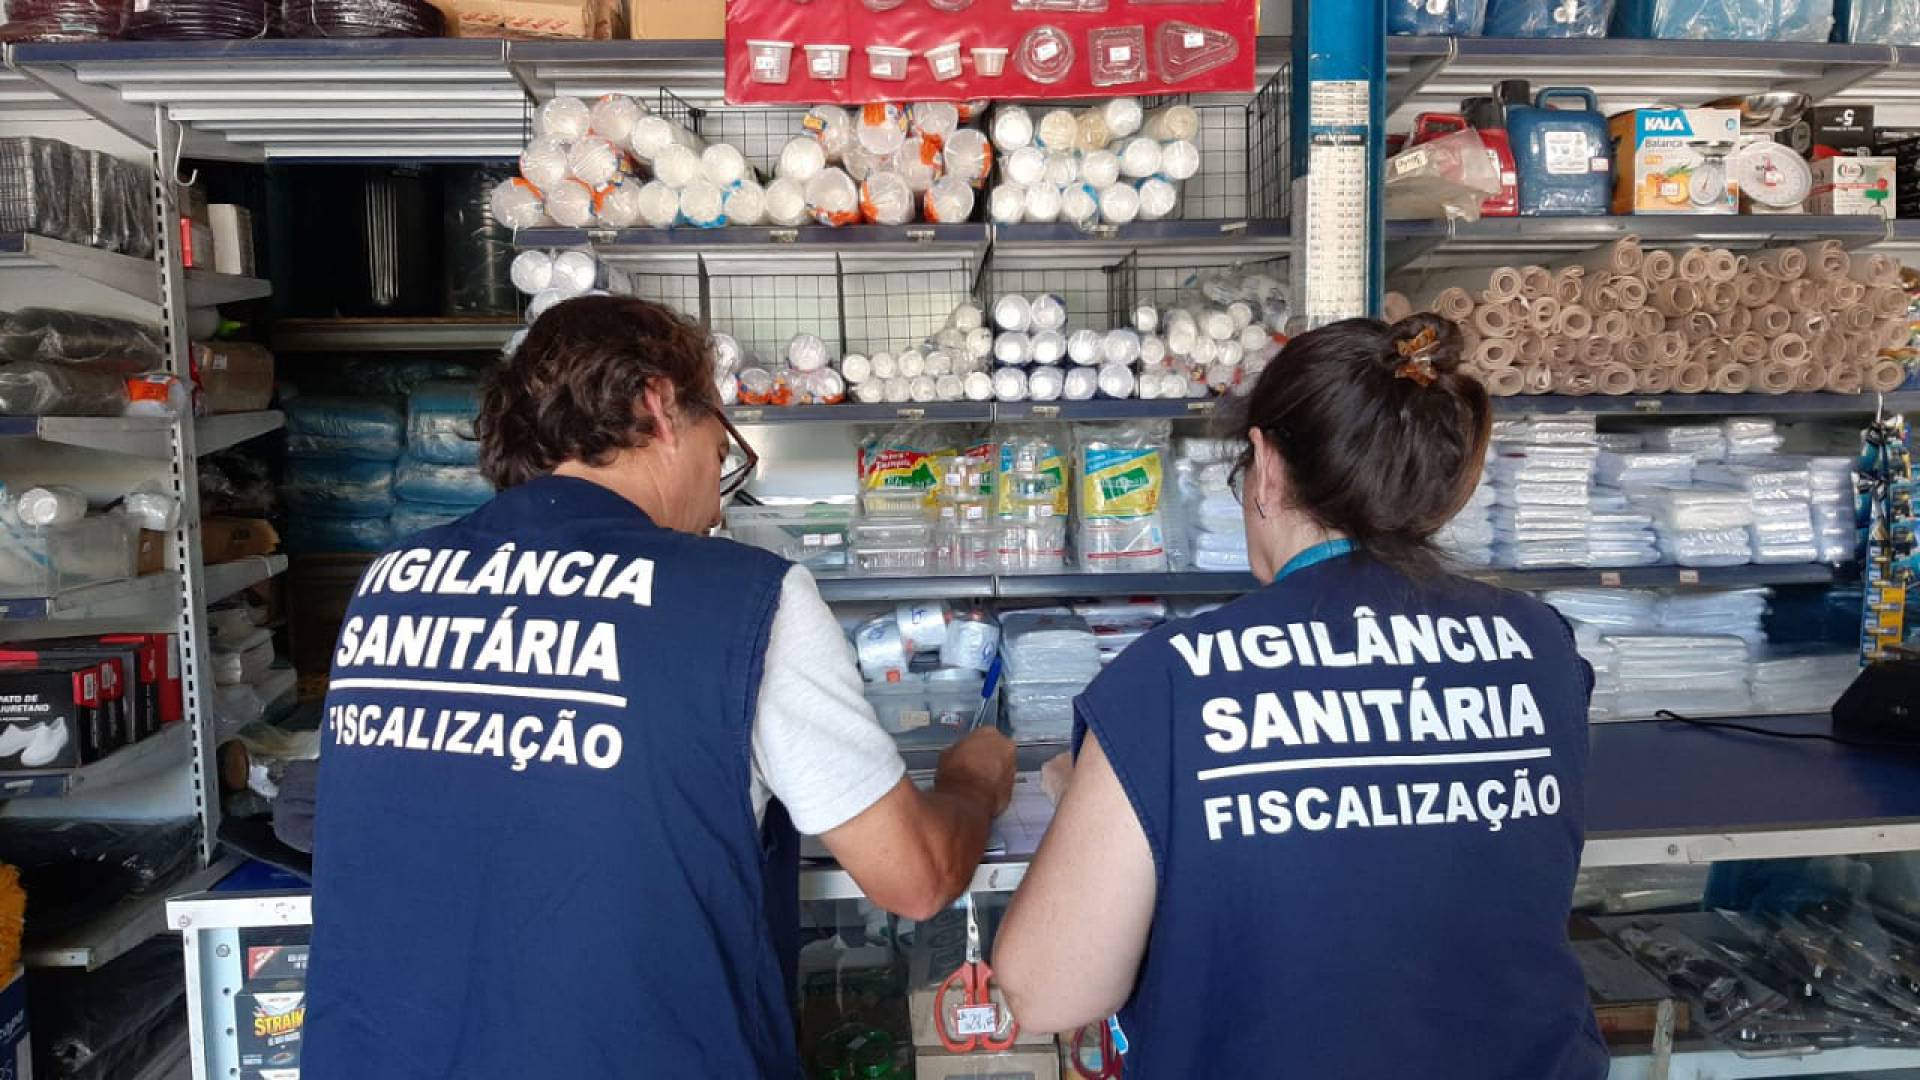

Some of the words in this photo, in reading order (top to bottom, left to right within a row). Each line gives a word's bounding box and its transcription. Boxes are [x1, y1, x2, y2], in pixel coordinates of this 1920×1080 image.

[1645, 116, 1684, 131] KALA
[358, 542, 654, 607] VIGILÂNCIA
[336, 606, 620, 682] SANITÁRIA
[1169, 605, 1533, 676] VIGILÂNCIA
[0, 703, 49, 713] IURETANO
[1202, 676, 1545, 753] SANITÁRIA
[1204, 768, 1561, 841] FISCALIZAÇÃO
